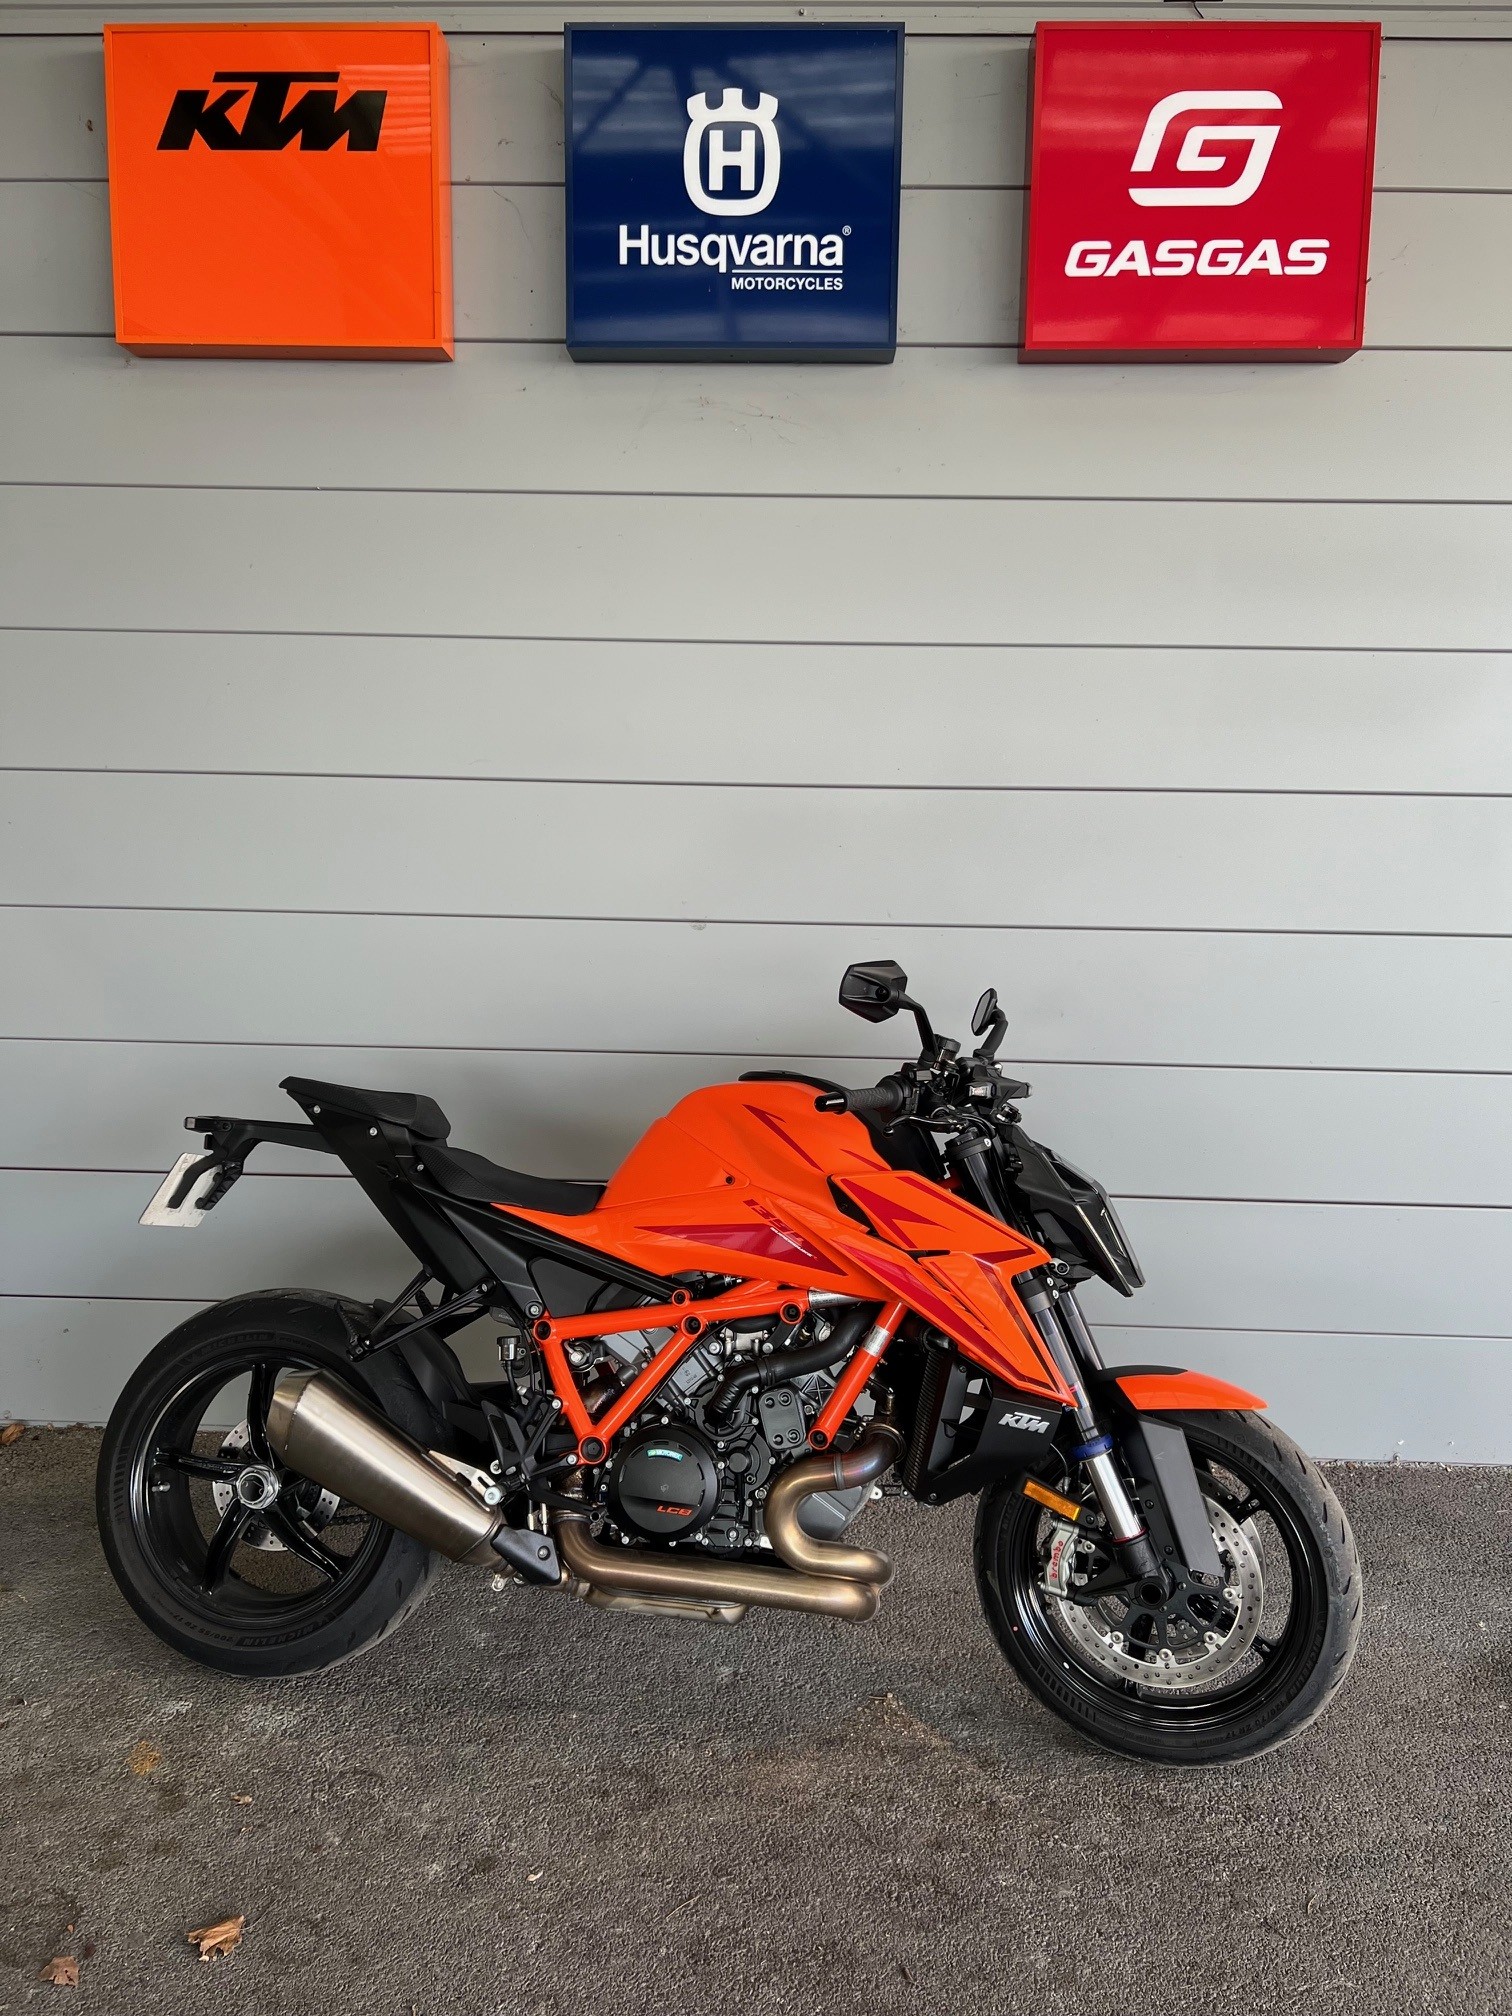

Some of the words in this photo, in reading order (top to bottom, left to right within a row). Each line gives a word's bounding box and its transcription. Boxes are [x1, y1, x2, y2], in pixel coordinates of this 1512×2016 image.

[157, 71, 388, 151] KTM
[708, 129, 756, 191] H
[1064, 238, 1330, 277] GASGAS
[731, 277, 843, 290] MOTORCYCLES
[998, 1411, 1050, 1434] KTM
[1050, 1540, 1064, 1579] brembo
[242, 1624, 315, 1647] MICHELIN
